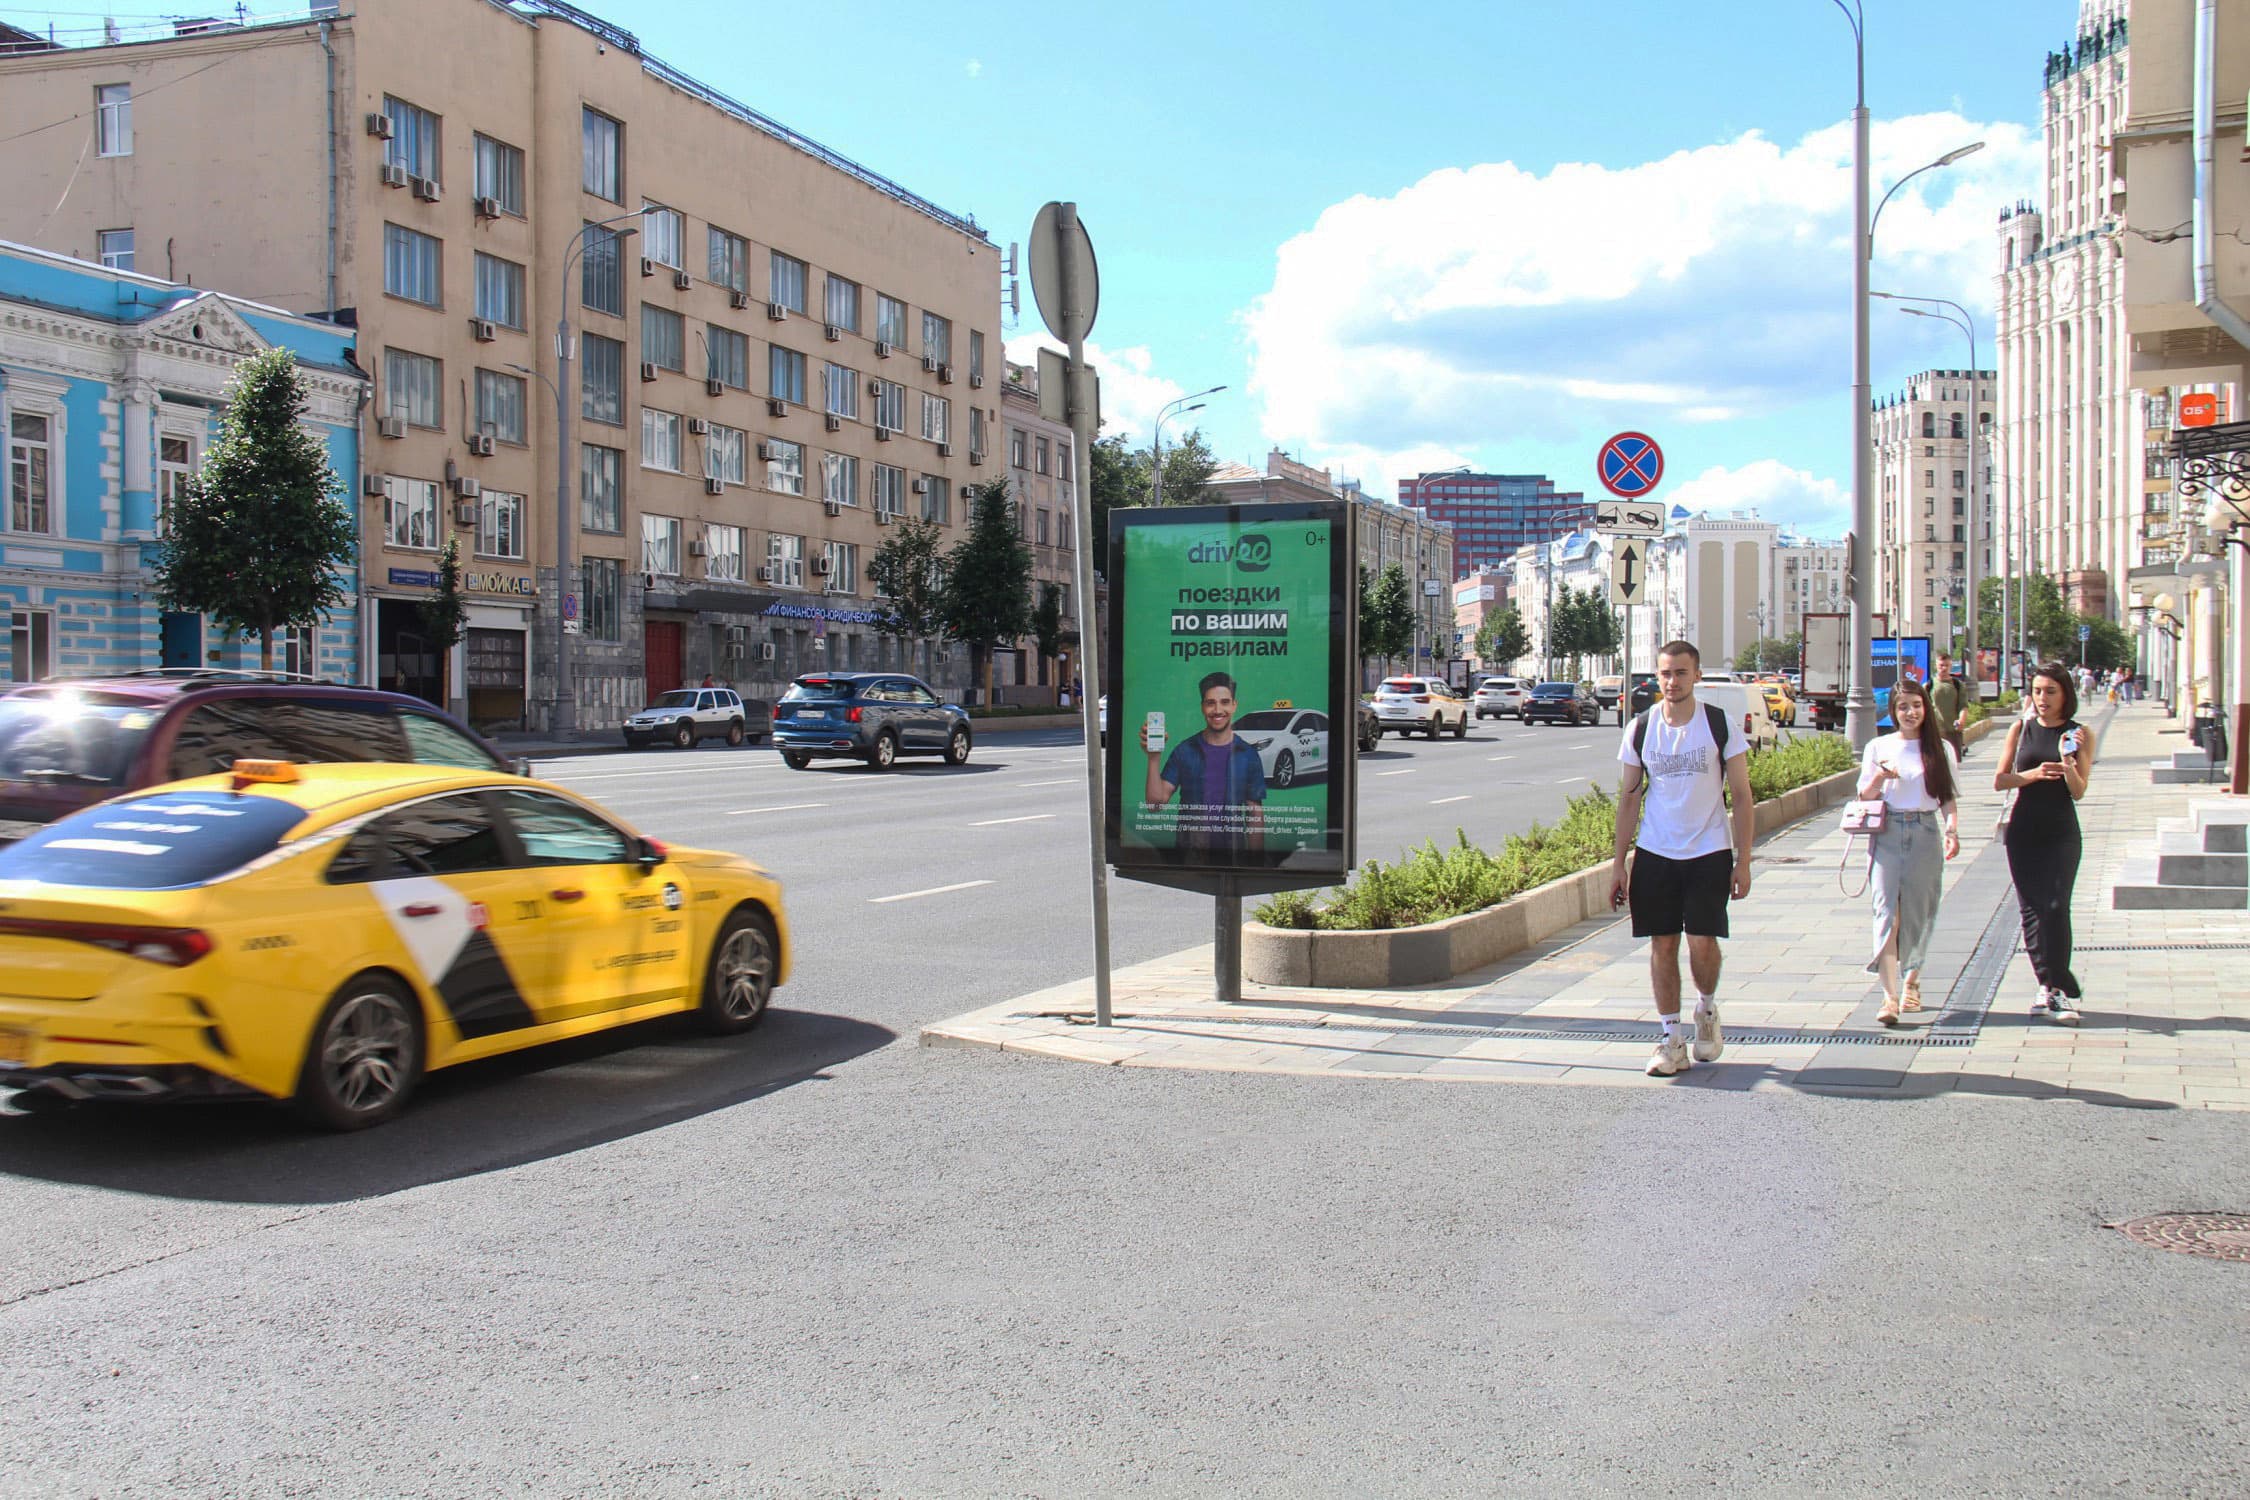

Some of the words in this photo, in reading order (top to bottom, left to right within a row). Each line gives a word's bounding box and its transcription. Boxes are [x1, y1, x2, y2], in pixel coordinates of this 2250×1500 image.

[1305, 531, 1327, 546] 0+
[479, 573, 521, 594] МОЙКА
[1178, 586, 1281, 605] поездки
[1171, 613, 1200, 631] по
[1206, 612, 1288, 630] вашим
[1170, 640, 1288, 661] правилам
